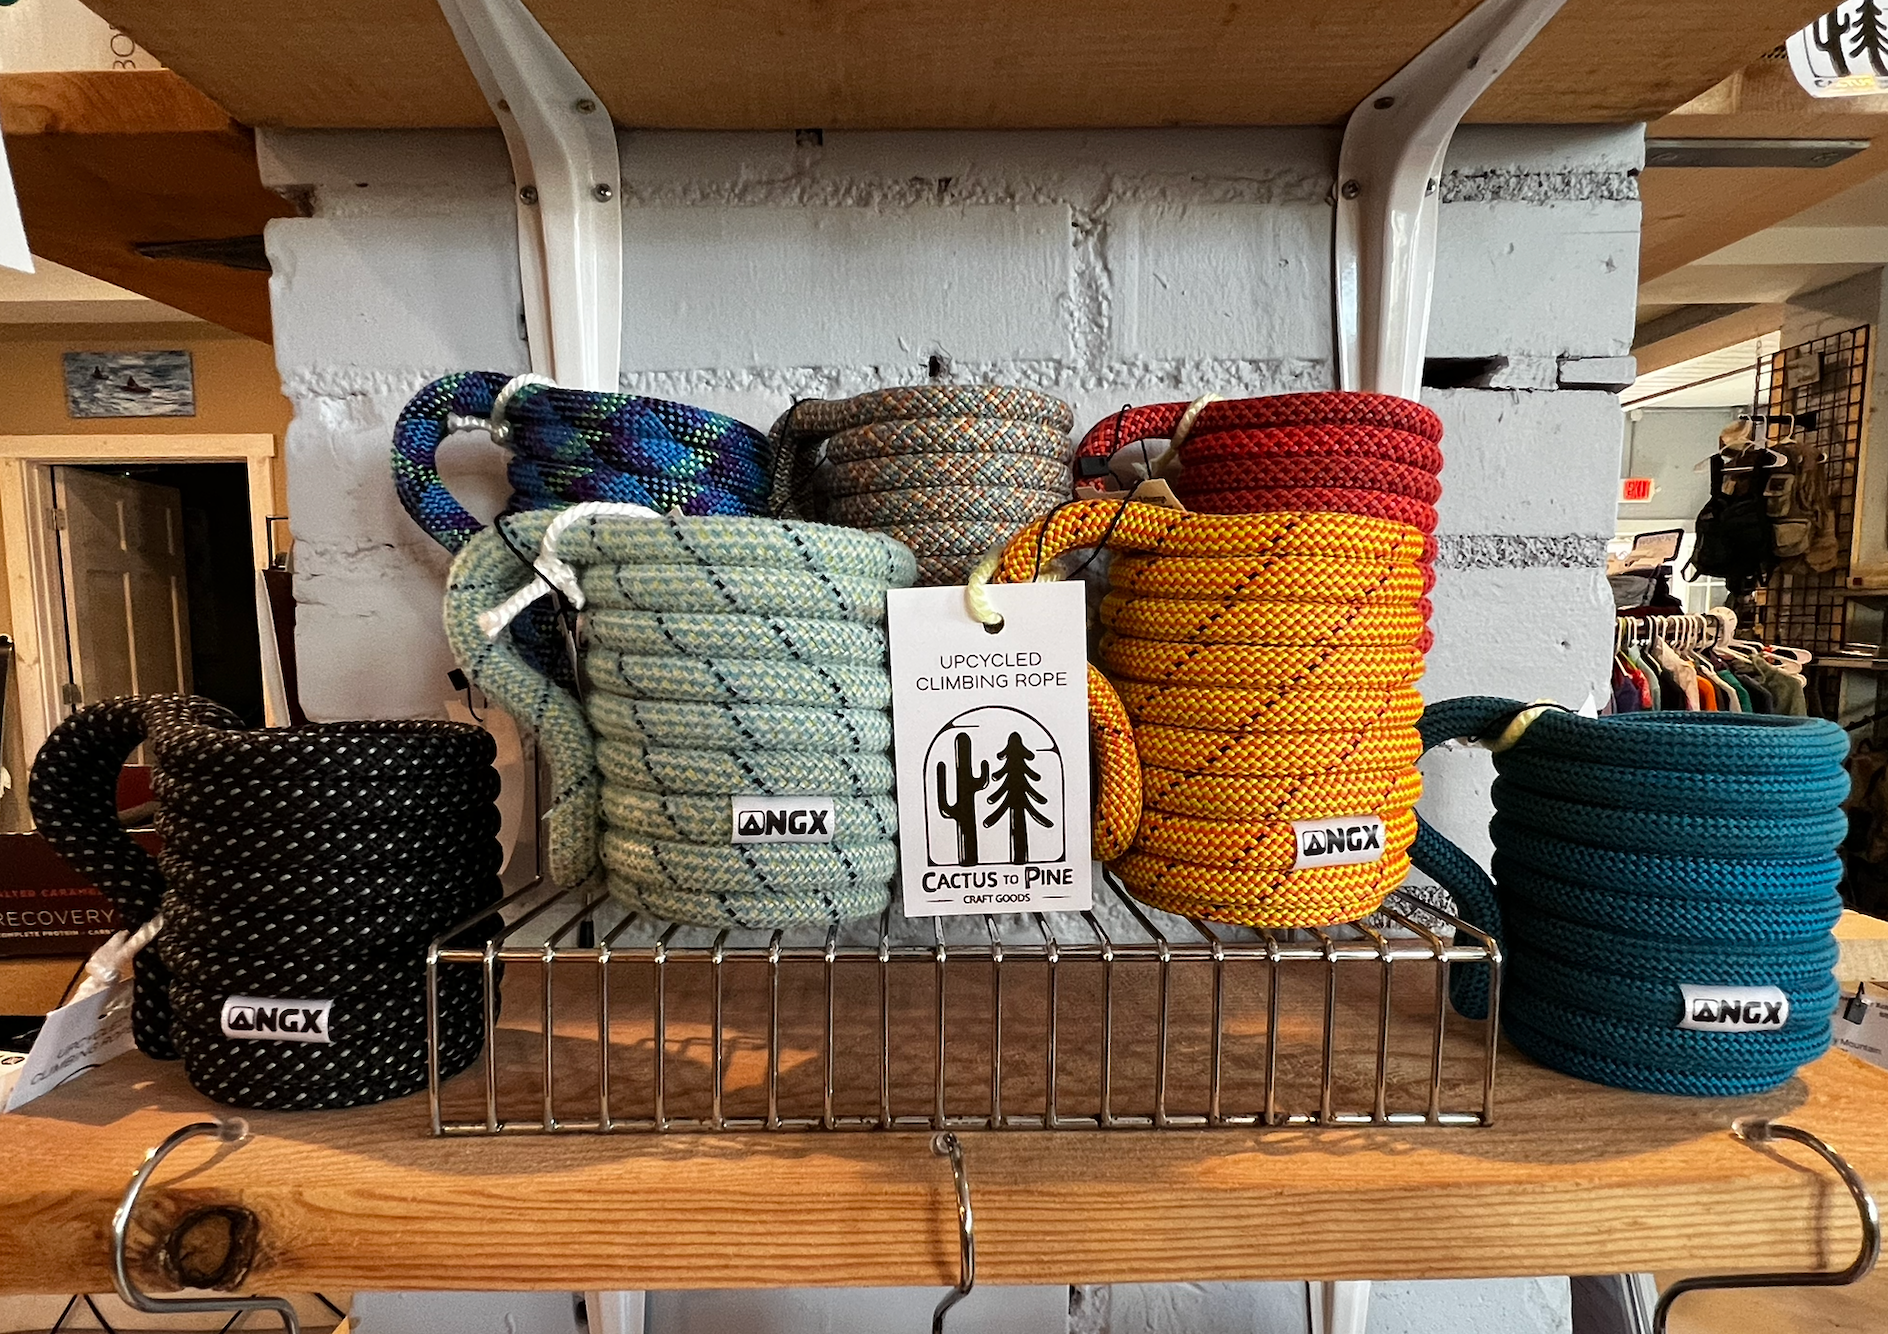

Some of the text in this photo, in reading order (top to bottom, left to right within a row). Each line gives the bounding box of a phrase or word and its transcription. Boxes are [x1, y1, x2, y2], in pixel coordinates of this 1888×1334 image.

[939, 651, 1042, 670] UPCYCLED
[916, 671, 1067, 691] CLIMBING ROPE
[921, 866, 1073, 893] CACTUS TO PINE
[963, 893, 1031, 904] CRAFT GOODS
[0, 908, 115, 927] RECOVERY
[0, 930, 40, 938] OMPLETE
[1840, 1038, 1882, 1055] Mountain
